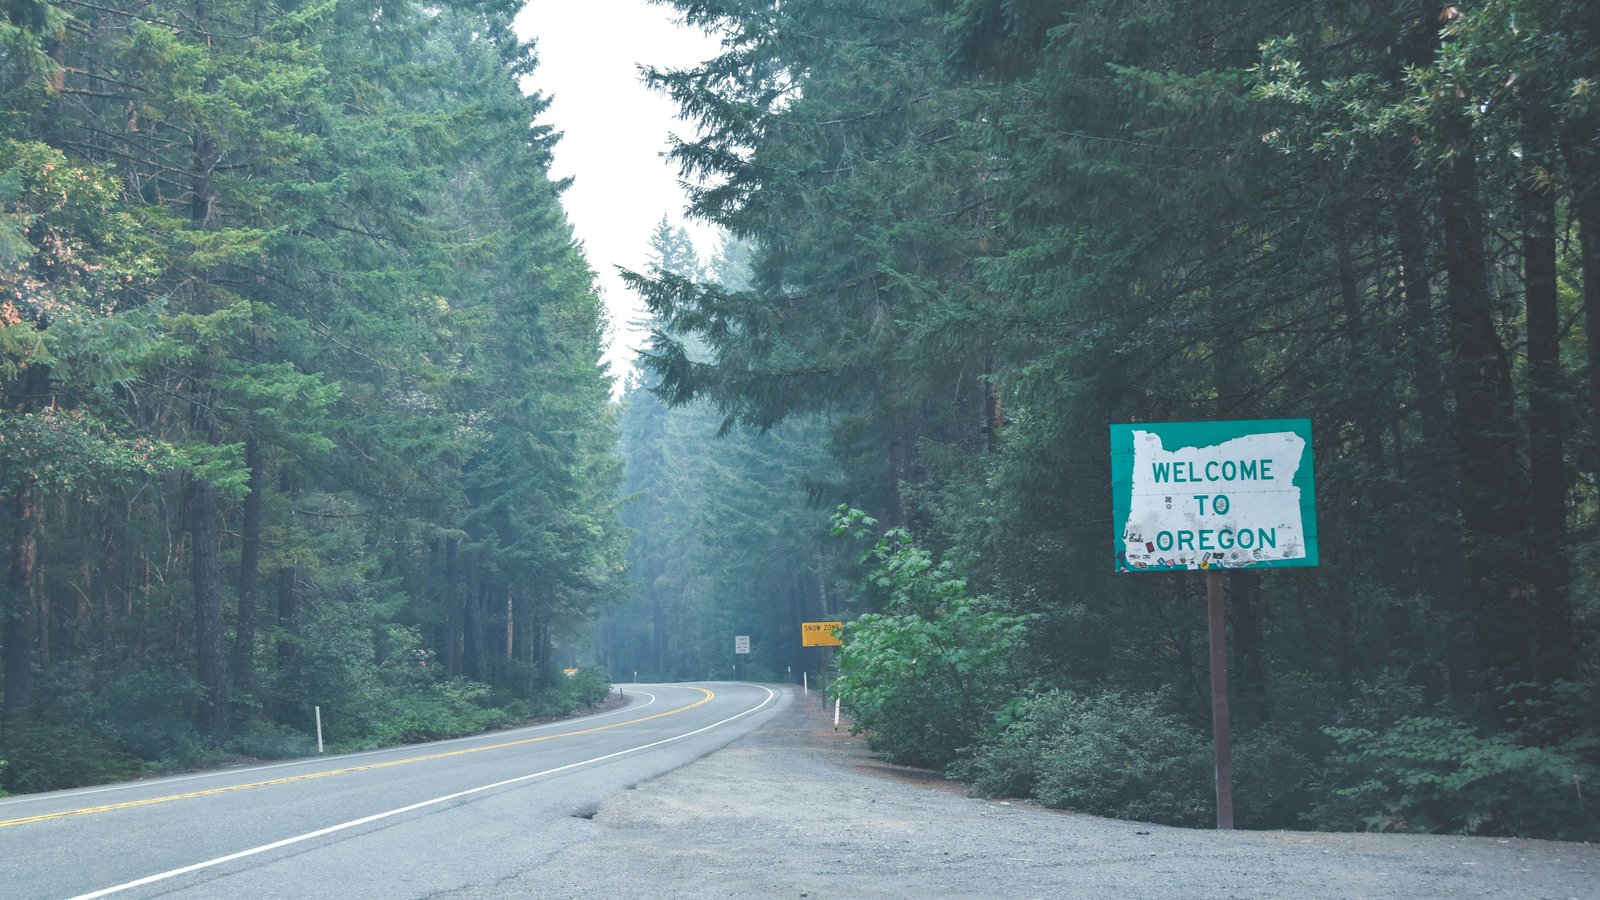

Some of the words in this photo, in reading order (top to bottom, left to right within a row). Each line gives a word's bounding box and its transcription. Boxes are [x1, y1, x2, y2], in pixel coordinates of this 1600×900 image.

[1152, 459, 1274, 483] WELCOME
[1193, 494, 1230, 515] TO
[1156, 528, 1276, 551] OREGON
[804, 624, 821, 632] SNOW
